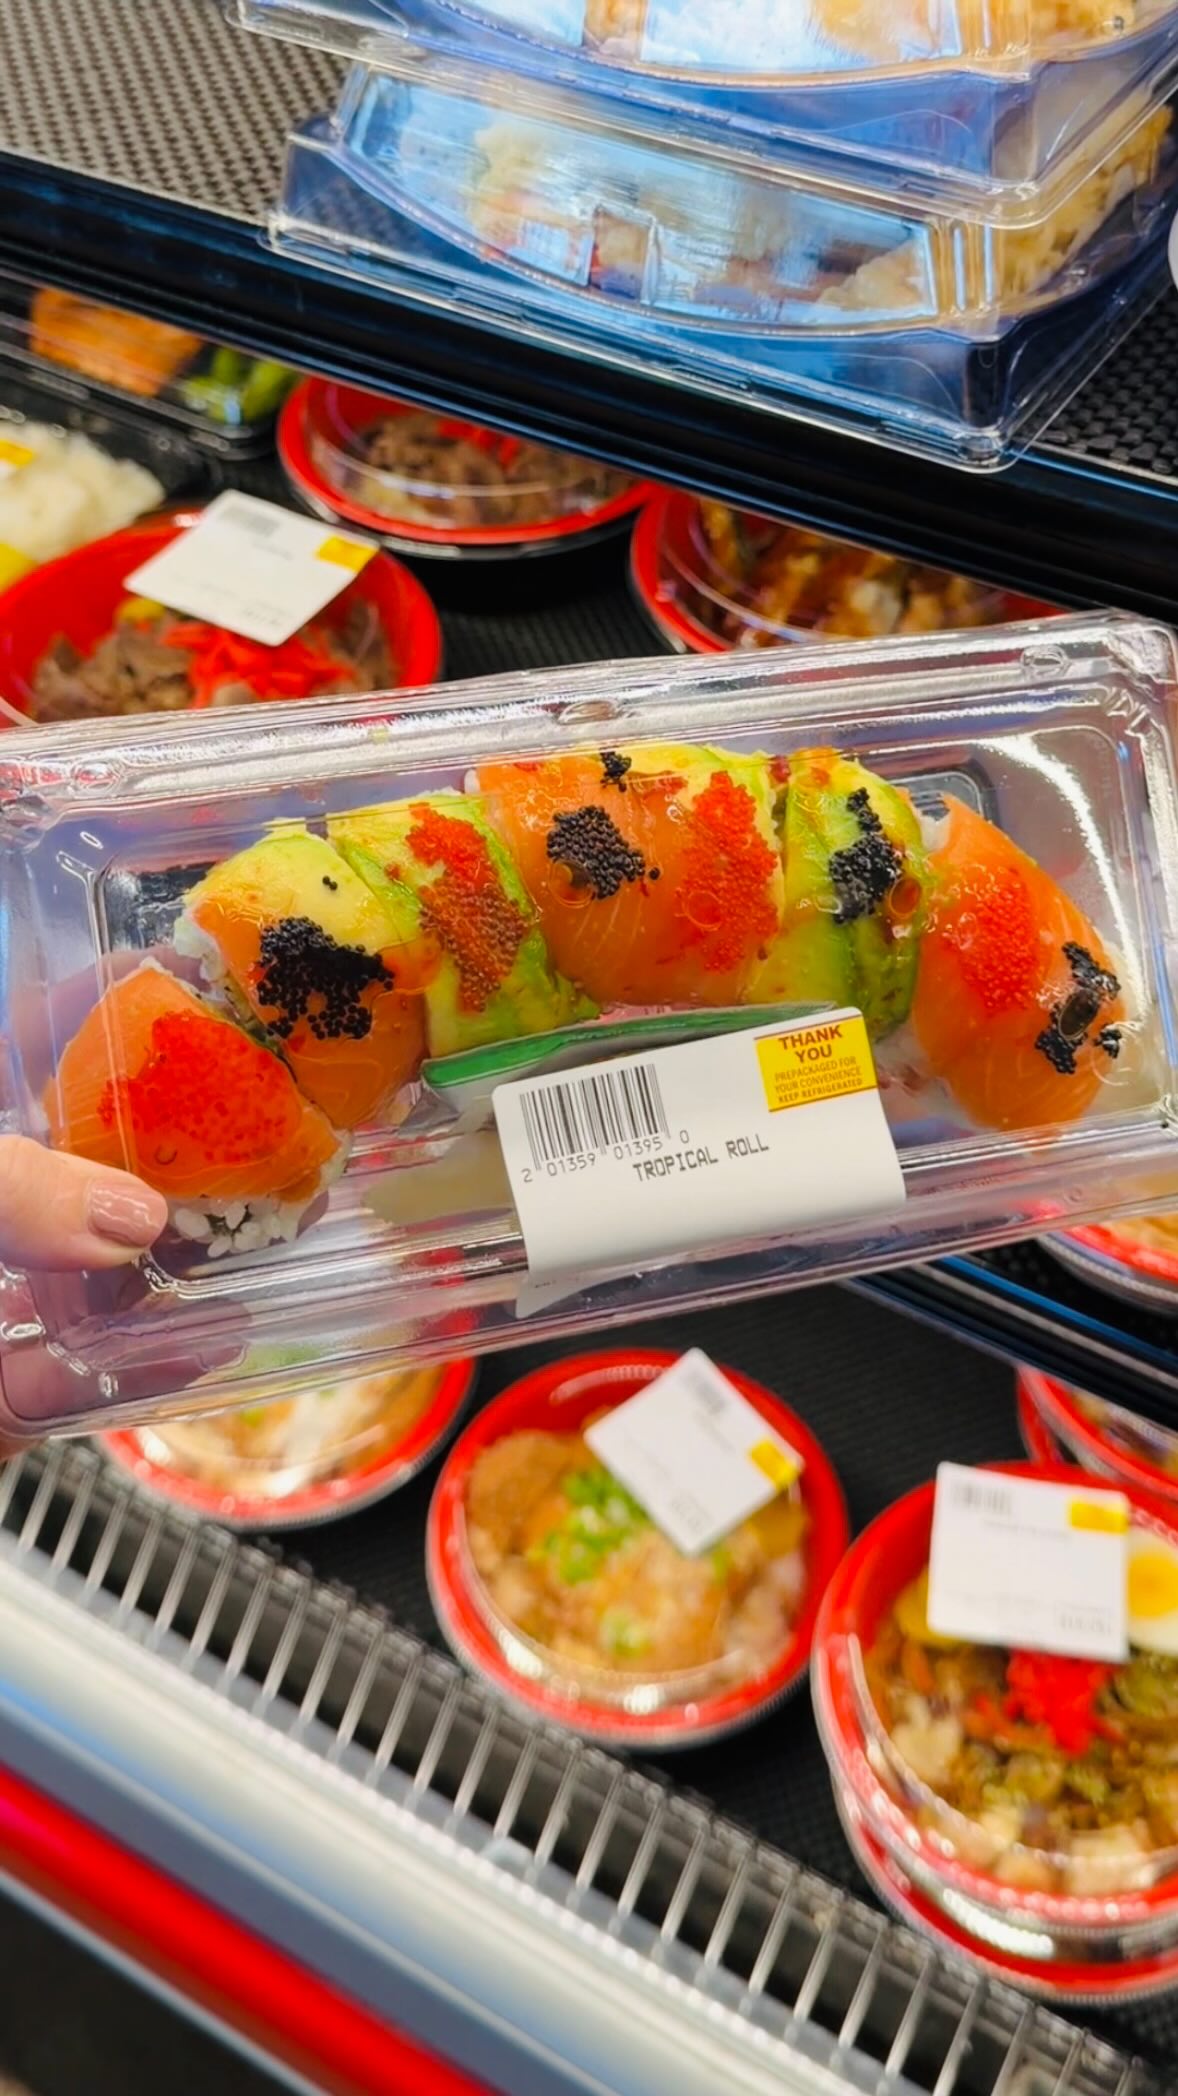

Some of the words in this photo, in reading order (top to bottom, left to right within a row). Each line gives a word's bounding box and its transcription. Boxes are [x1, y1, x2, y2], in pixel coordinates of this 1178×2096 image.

[778, 1025, 843, 1050] THANK
[795, 1044, 832, 1063] YOU
[774, 1062, 837, 1082] PREPACKAGED
[839, 1056, 857, 1068] FOR
[775, 1080, 799, 1094] YOUR
[799, 1066, 862, 1088] CONVENIENCE
[778, 1092, 799, 1104] KEEP
[801, 1078, 863, 1099] REFRIGERATED
[521, 1168, 533, 1183] 2
[547, 1153, 597, 1177] 01359
[613, 1136, 664, 1160] 01395
[679, 1129, 690, 1144] 0
[632, 1148, 719, 1182] TROPICAL
[726, 1134, 770, 1156] ROLL
